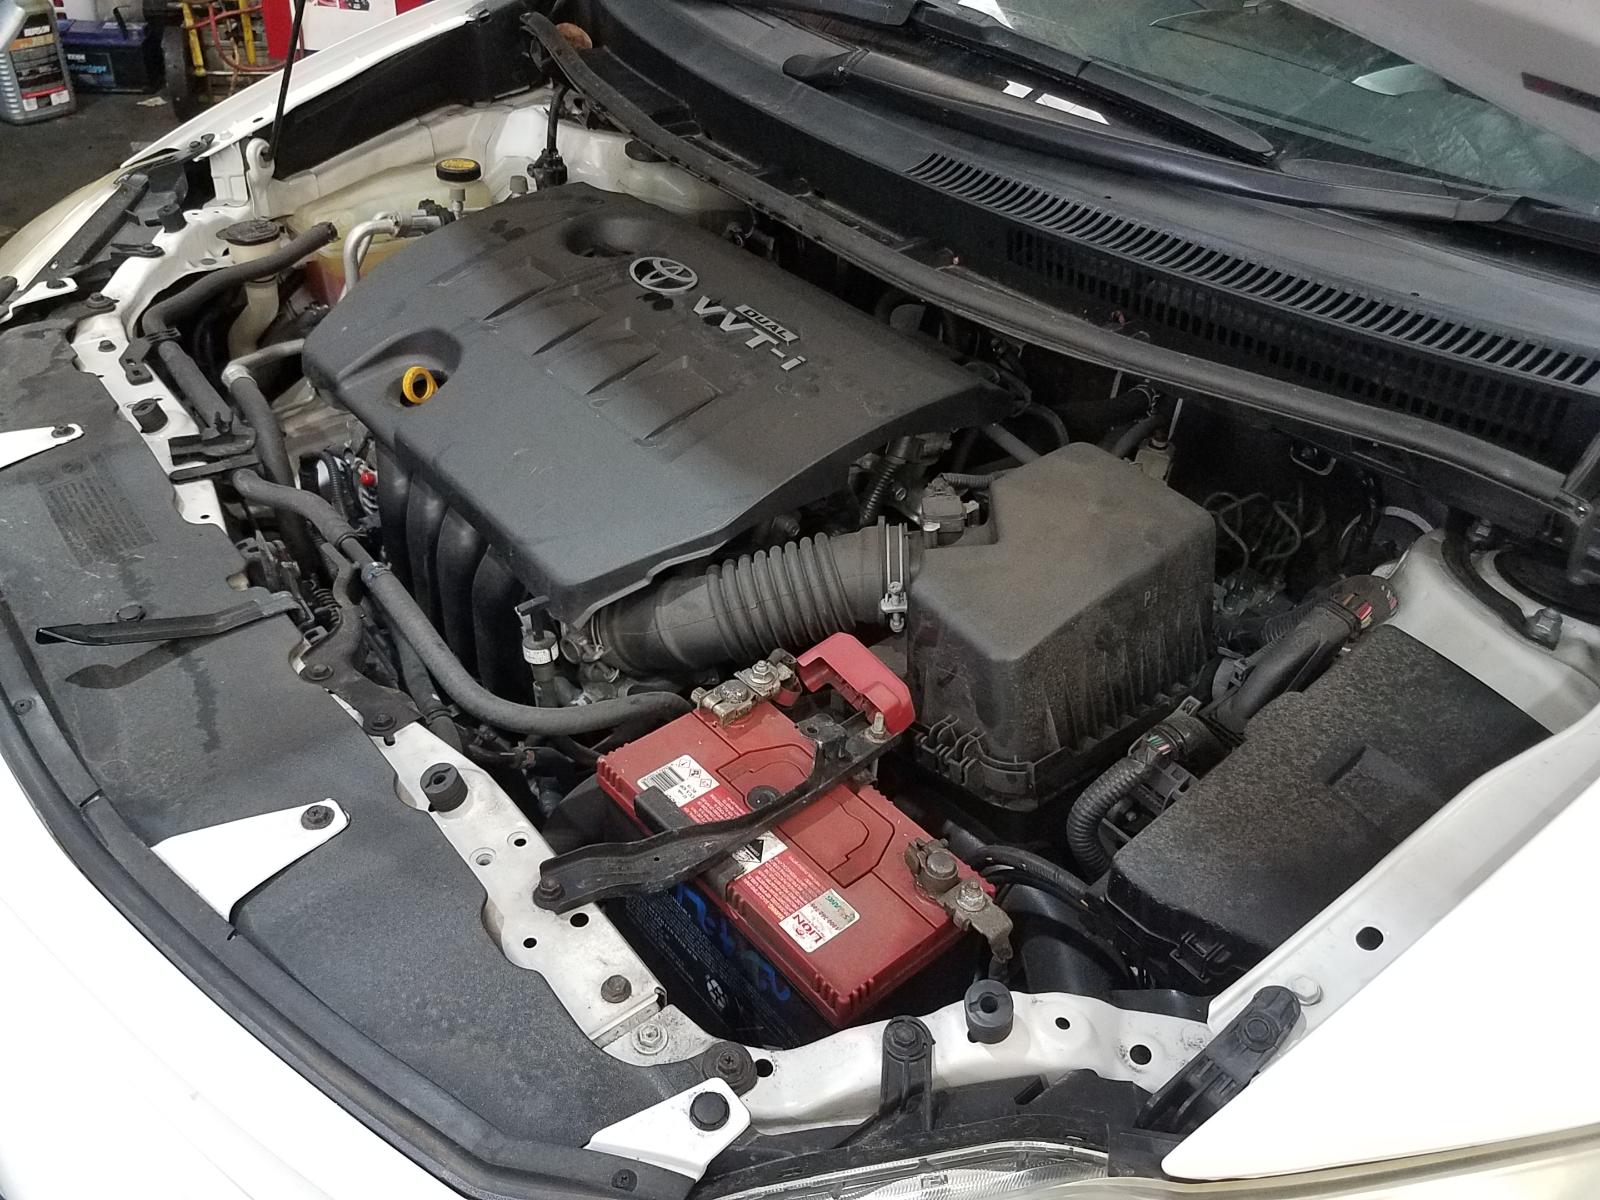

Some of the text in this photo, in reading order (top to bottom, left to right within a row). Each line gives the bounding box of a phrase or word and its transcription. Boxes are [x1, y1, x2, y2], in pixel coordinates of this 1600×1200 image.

[692, 295, 808, 373] VVT-i
[743, 307, 790, 340] DUAL
[792, 912, 823, 944] LION
